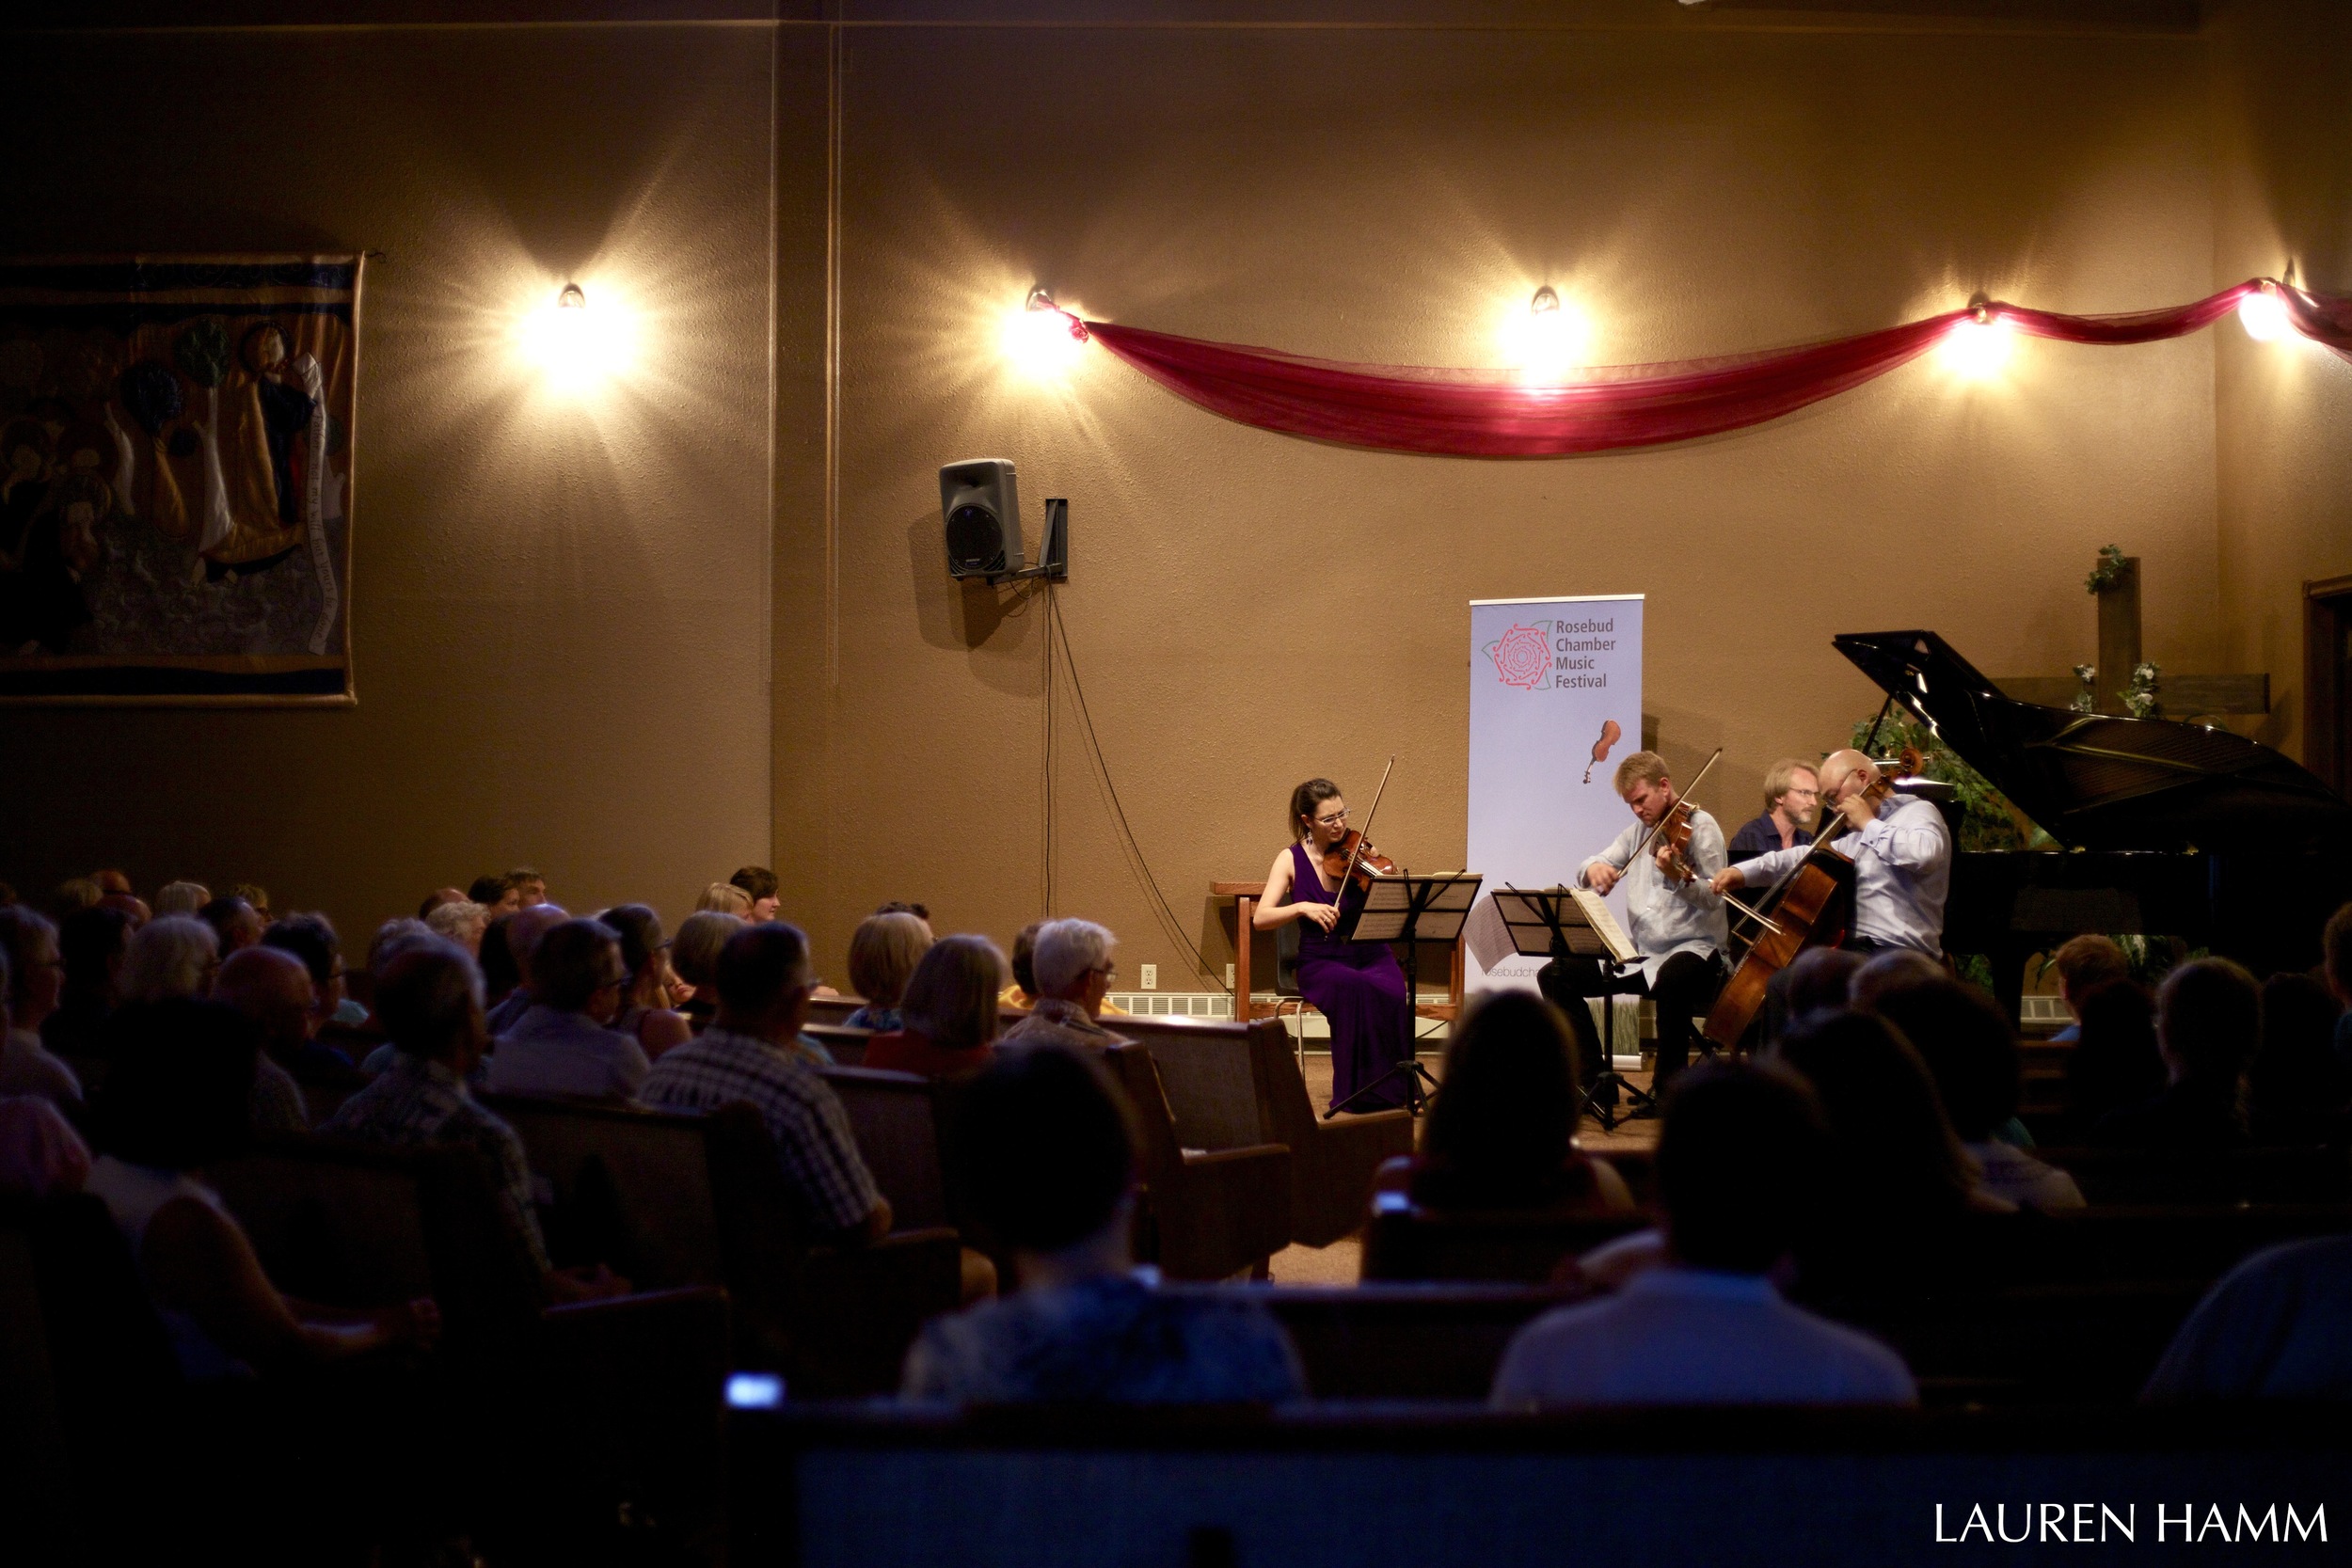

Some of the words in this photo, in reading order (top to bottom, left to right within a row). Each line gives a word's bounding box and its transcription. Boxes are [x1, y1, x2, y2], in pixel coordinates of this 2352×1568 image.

[310, 462, 321, 481] not
[308, 487, 318, 505] my
[310, 511, 322, 531] will
[311, 538, 325, 557] but
[325, 596, 337, 609] be
[1556, 618, 1613, 634] Rosebud
[1556, 637, 1616, 652] Chamber
[1556, 656, 1595, 670] Music
[1555, 673, 1607, 689] Festival
